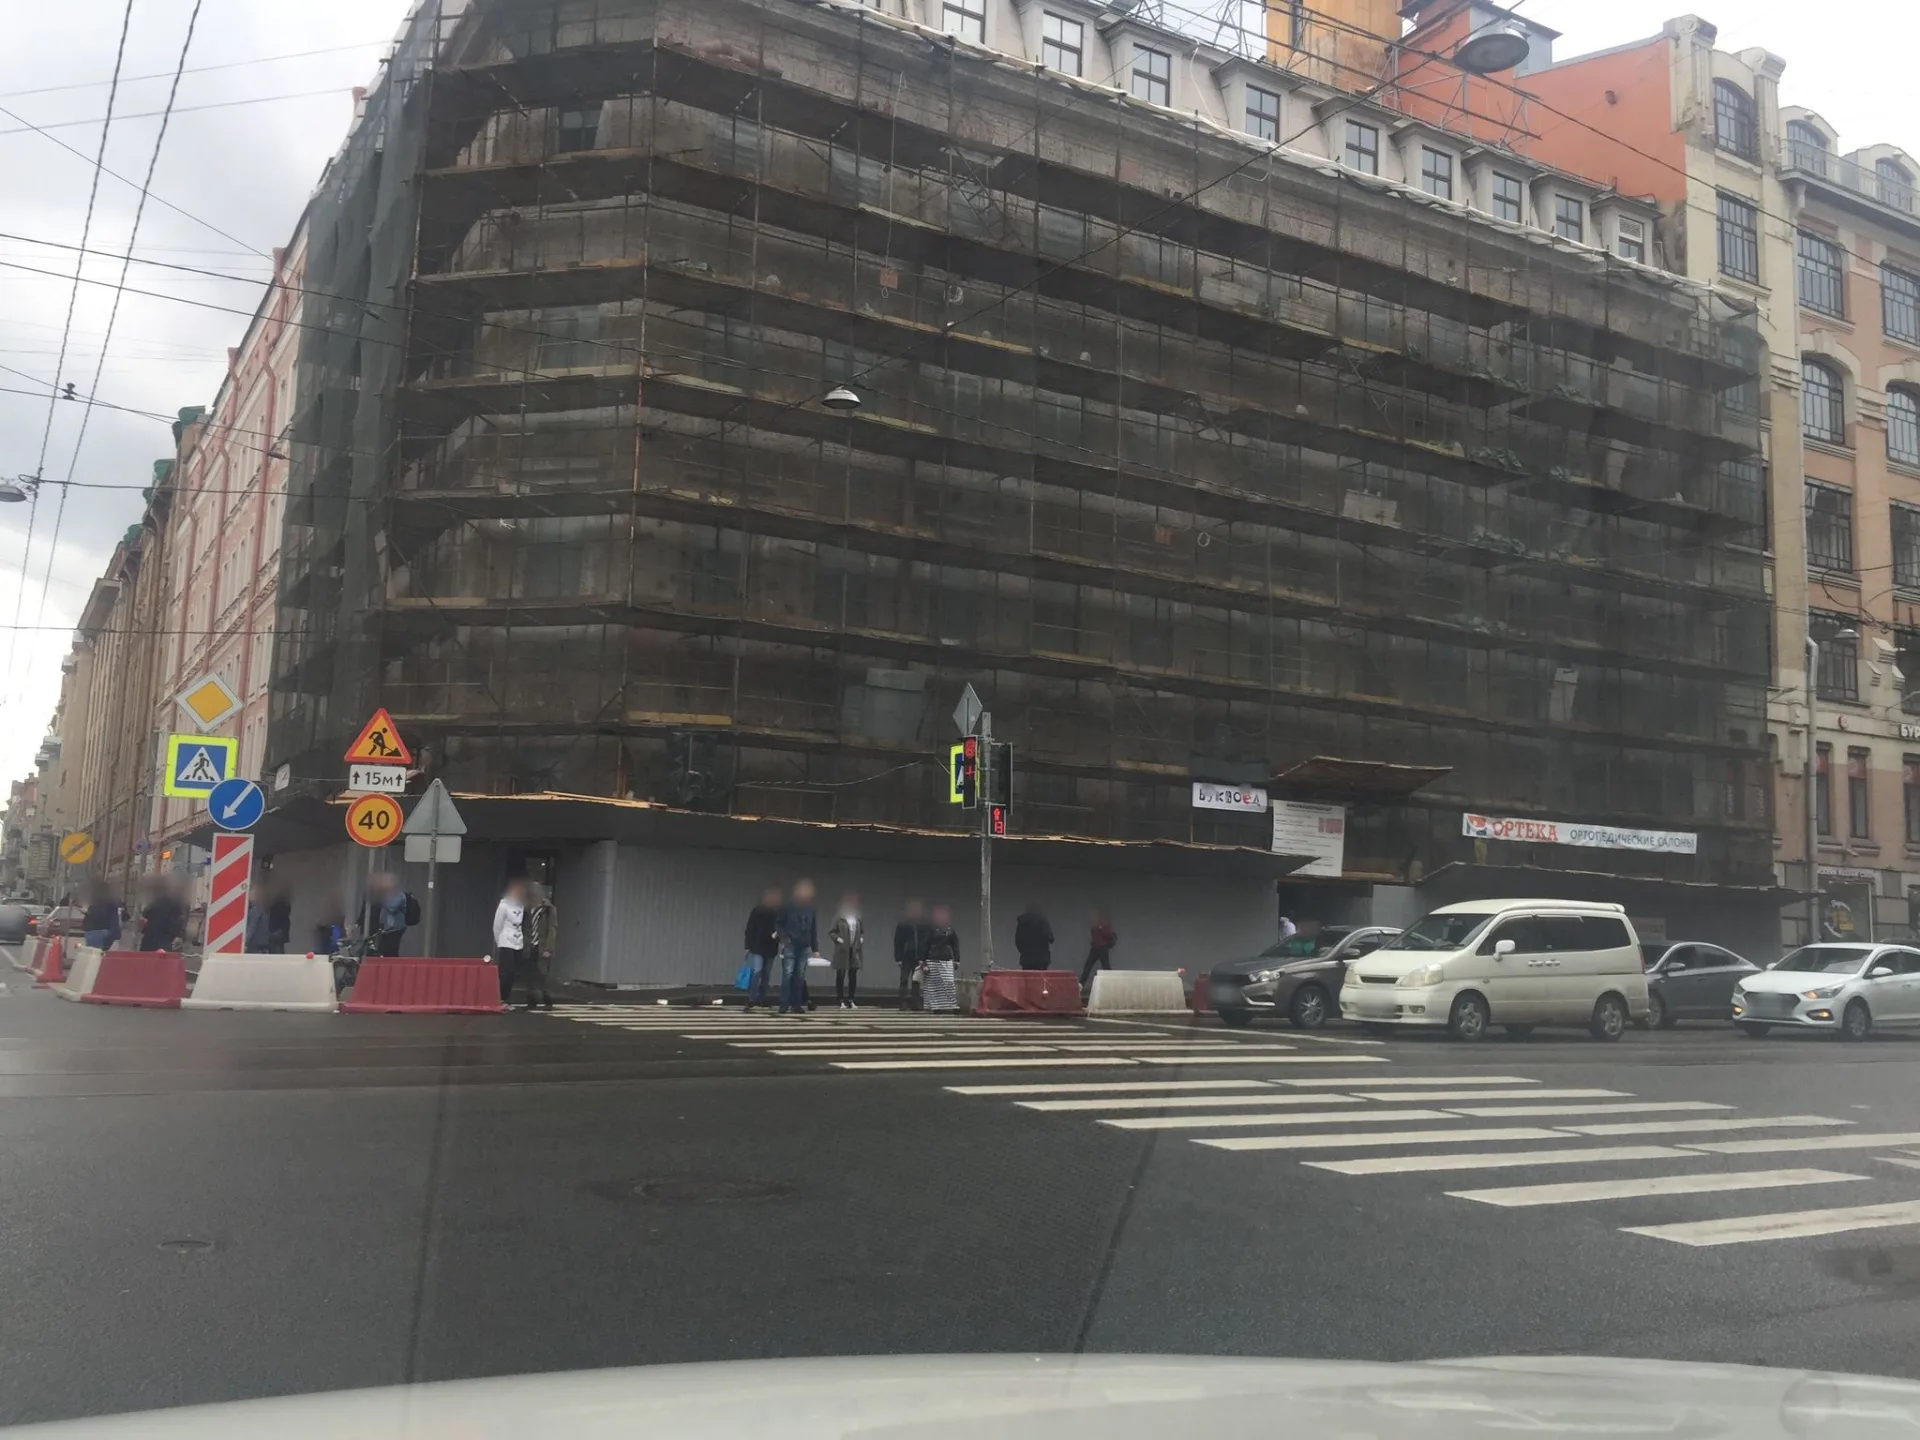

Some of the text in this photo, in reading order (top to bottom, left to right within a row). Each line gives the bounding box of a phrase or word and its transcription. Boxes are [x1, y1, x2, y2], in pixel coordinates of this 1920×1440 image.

[358, 810, 390, 830] 40
[1491, 819, 1695, 849] ОРТЕКА ОРТОПЕДИЧЕСКИЕ САЛОНЫ
